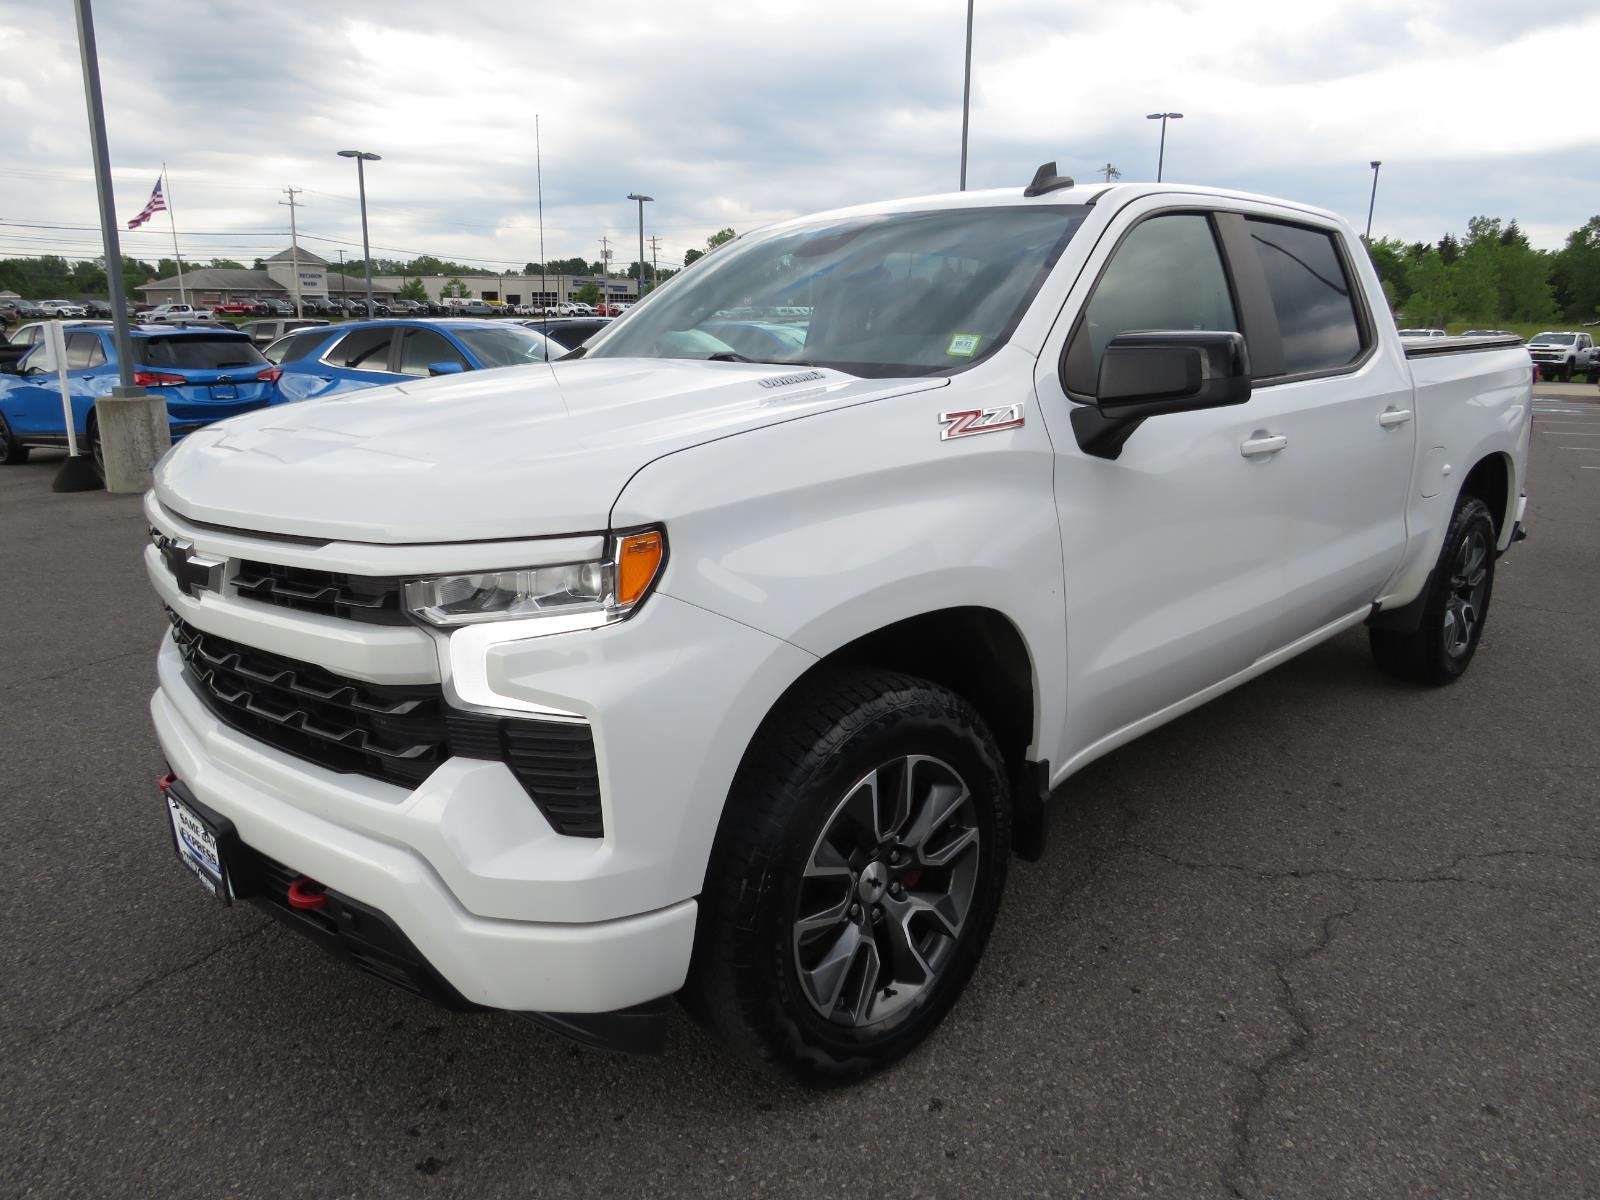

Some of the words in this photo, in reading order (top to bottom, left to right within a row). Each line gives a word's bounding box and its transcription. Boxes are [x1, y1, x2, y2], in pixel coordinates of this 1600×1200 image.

[938, 402, 1025, 441] Z71
[179, 812, 201, 836] SAME
[201, 832, 216, 850] DAY
[180, 827, 217, 864] EXPRESS
